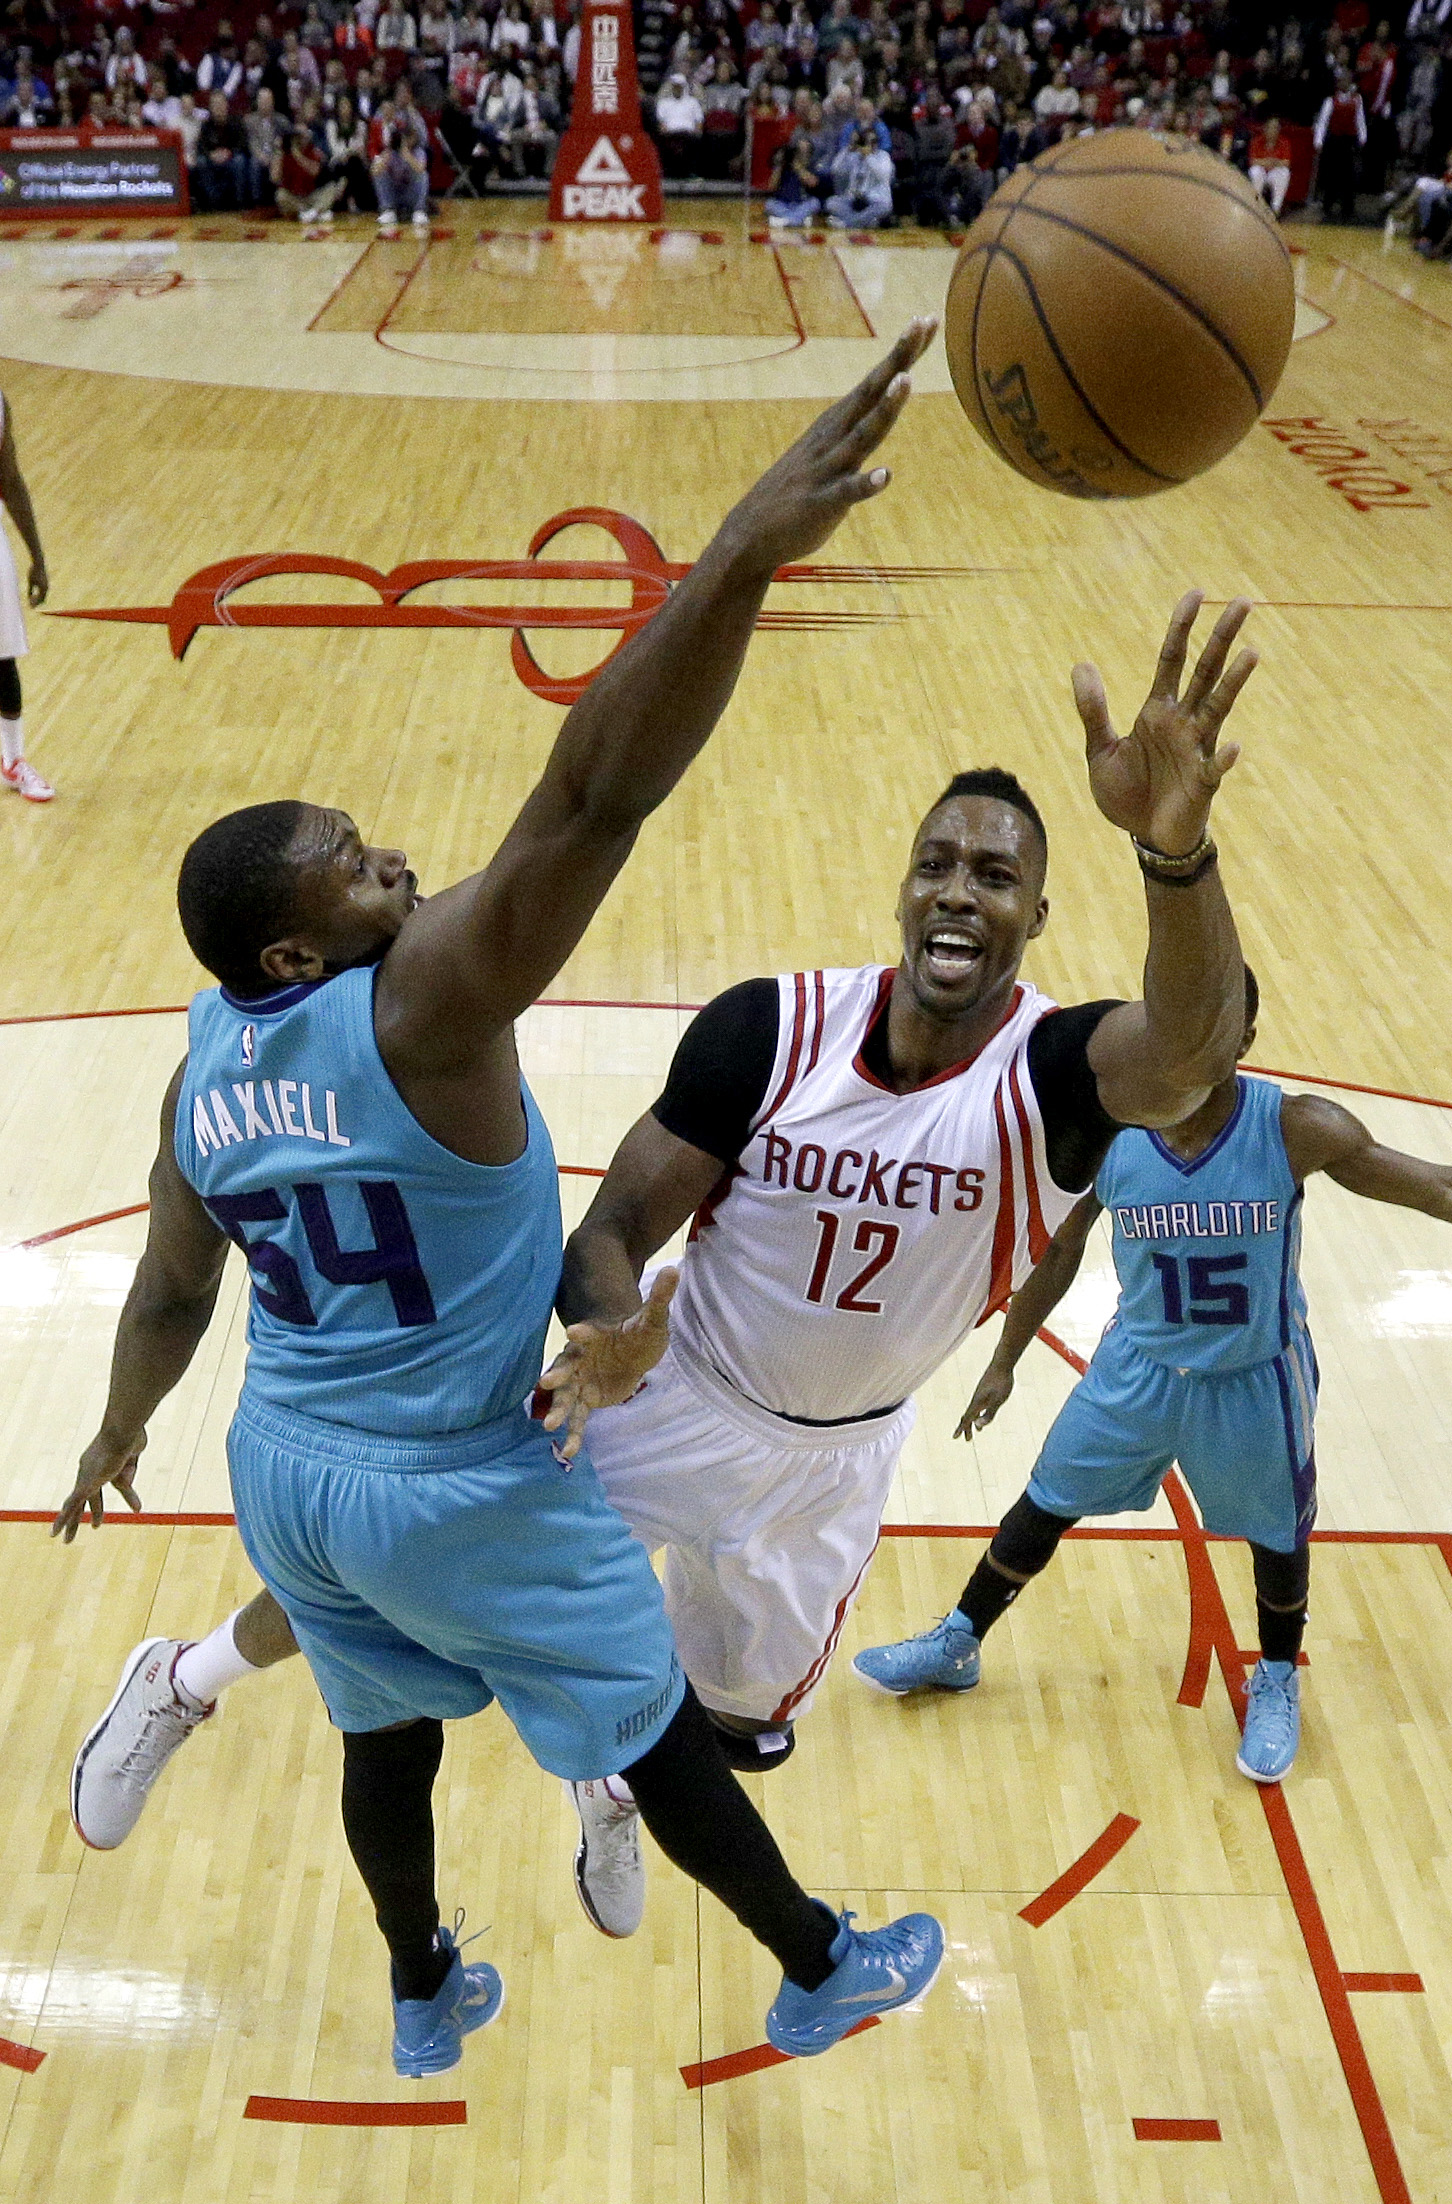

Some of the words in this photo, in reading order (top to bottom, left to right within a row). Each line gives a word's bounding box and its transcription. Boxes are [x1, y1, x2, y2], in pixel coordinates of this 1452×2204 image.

[60, 181, 117, 198] Houston
[118, 180, 174, 197] Rockets
[109, 161, 160, 178] Partner
[562, 184, 647, 218] PEAK
[1259, 416, 1432, 512] TOYOTA
[194, 1080, 351, 1157] MAXIELL
[758, 1125, 986, 1216] ROCKETS
[202, 1181, 437, 1327] 54
[1116, 1200, 1279, 1240] CHARLOTTE
[805, 1208, 901, 1315] 12
[1152, 1252, 1250, 1325] 15
